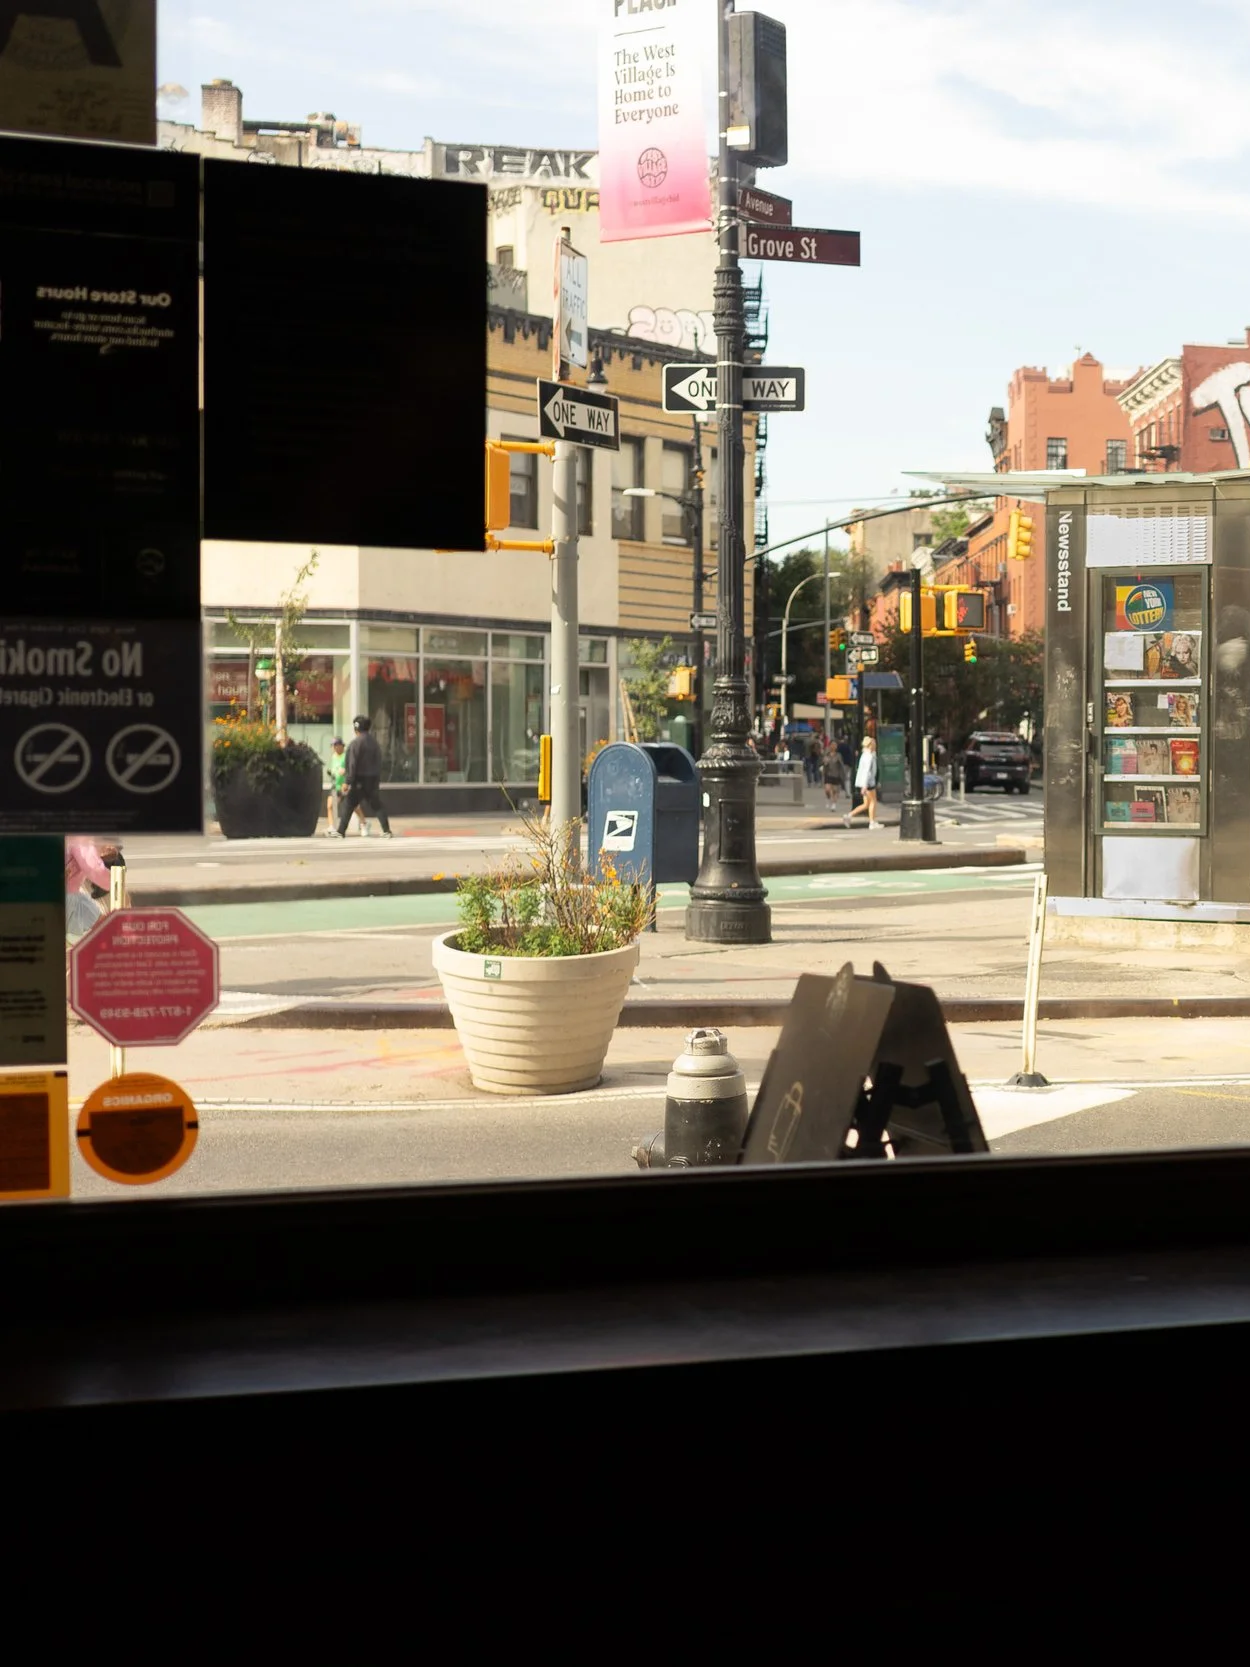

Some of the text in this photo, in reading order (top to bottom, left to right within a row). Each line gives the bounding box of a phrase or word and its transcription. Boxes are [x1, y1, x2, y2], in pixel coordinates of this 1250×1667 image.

[614, 44, 675, 66] The West
[614, 62, 676, 85] Village Is
[614, 85, 672, 105] Home to
[614, 103, 680, 125] Everyone
[745, 191, 774, 216] Avenue
[748, 233, 818, 260] Grove St
[565, 259, 581, 289] ALL
[562, 287, 586, 320] TRAFFIC
[752, 380, 790, 398] WAY
[552, 400, 610, 433] ONE WAY
[1056, 510, 1073, 612] Newsstand
[1143, 590, 1158, 598] NEW
[1144, 598, 1162, 609] YORK
[1128, 607, 1164, 625] LOTTERY
